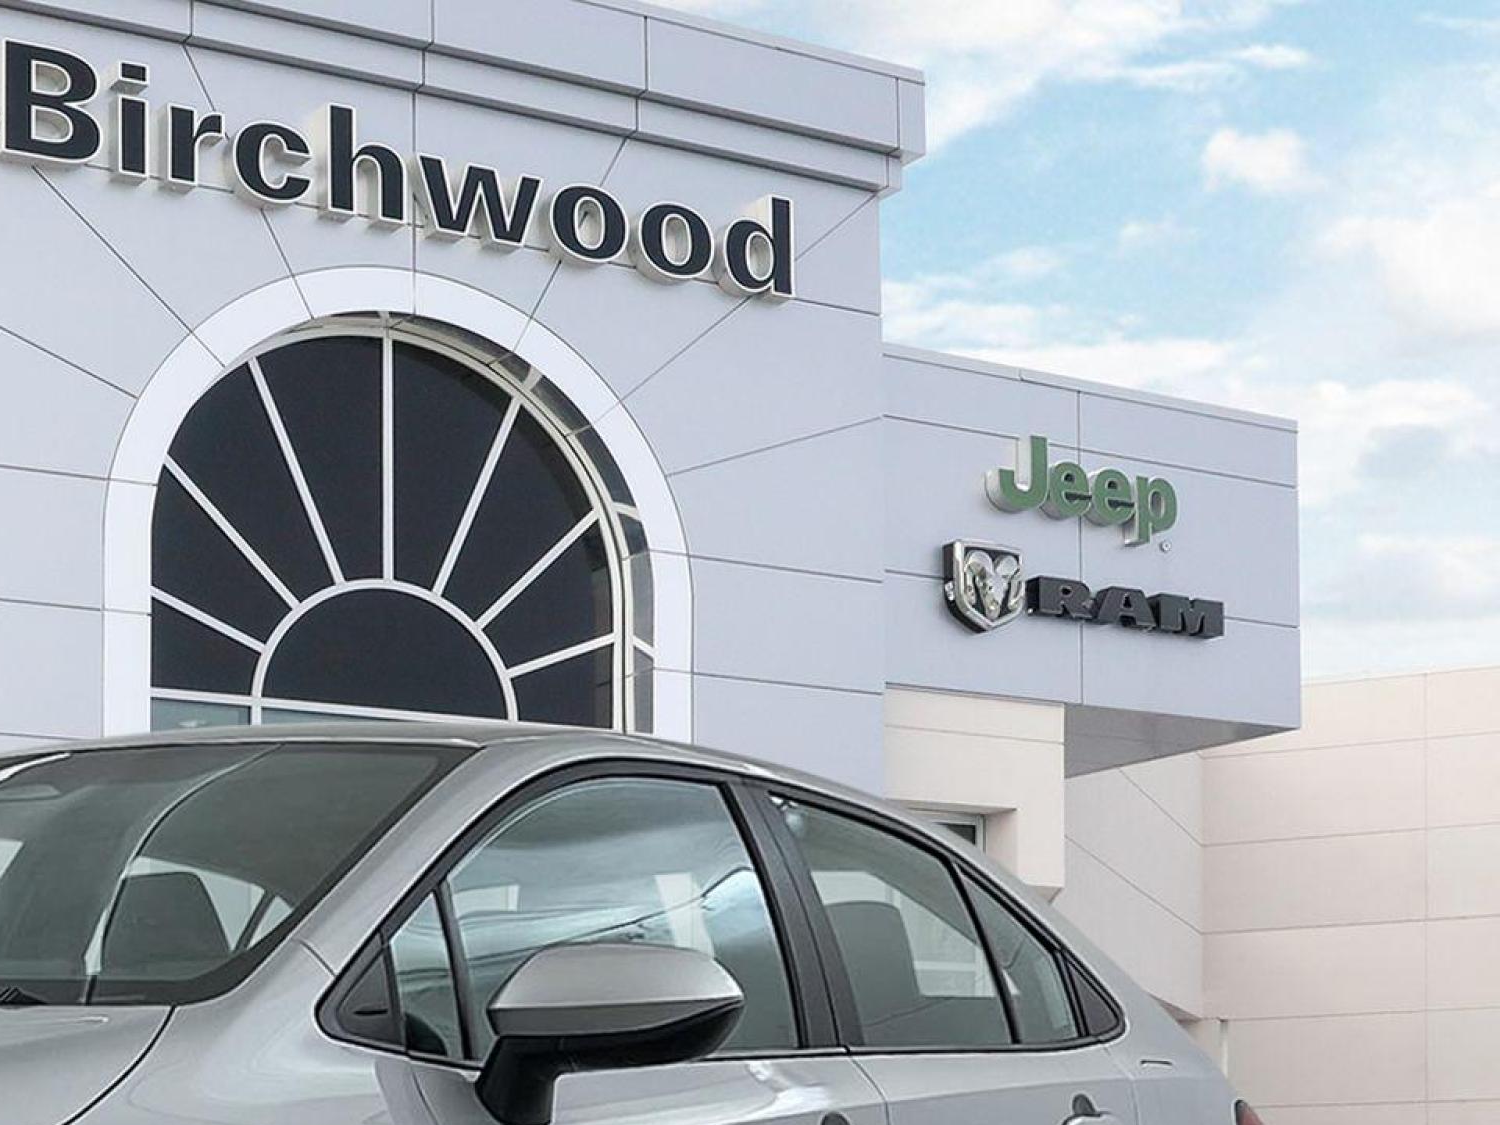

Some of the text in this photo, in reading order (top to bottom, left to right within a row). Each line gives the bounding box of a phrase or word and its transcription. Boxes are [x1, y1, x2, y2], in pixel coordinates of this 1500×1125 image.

[0, 39, 794, 299] Birchwood
[987, 435, 1178, 546] Jeep
[1026, 575, 1225, 639] RAM
